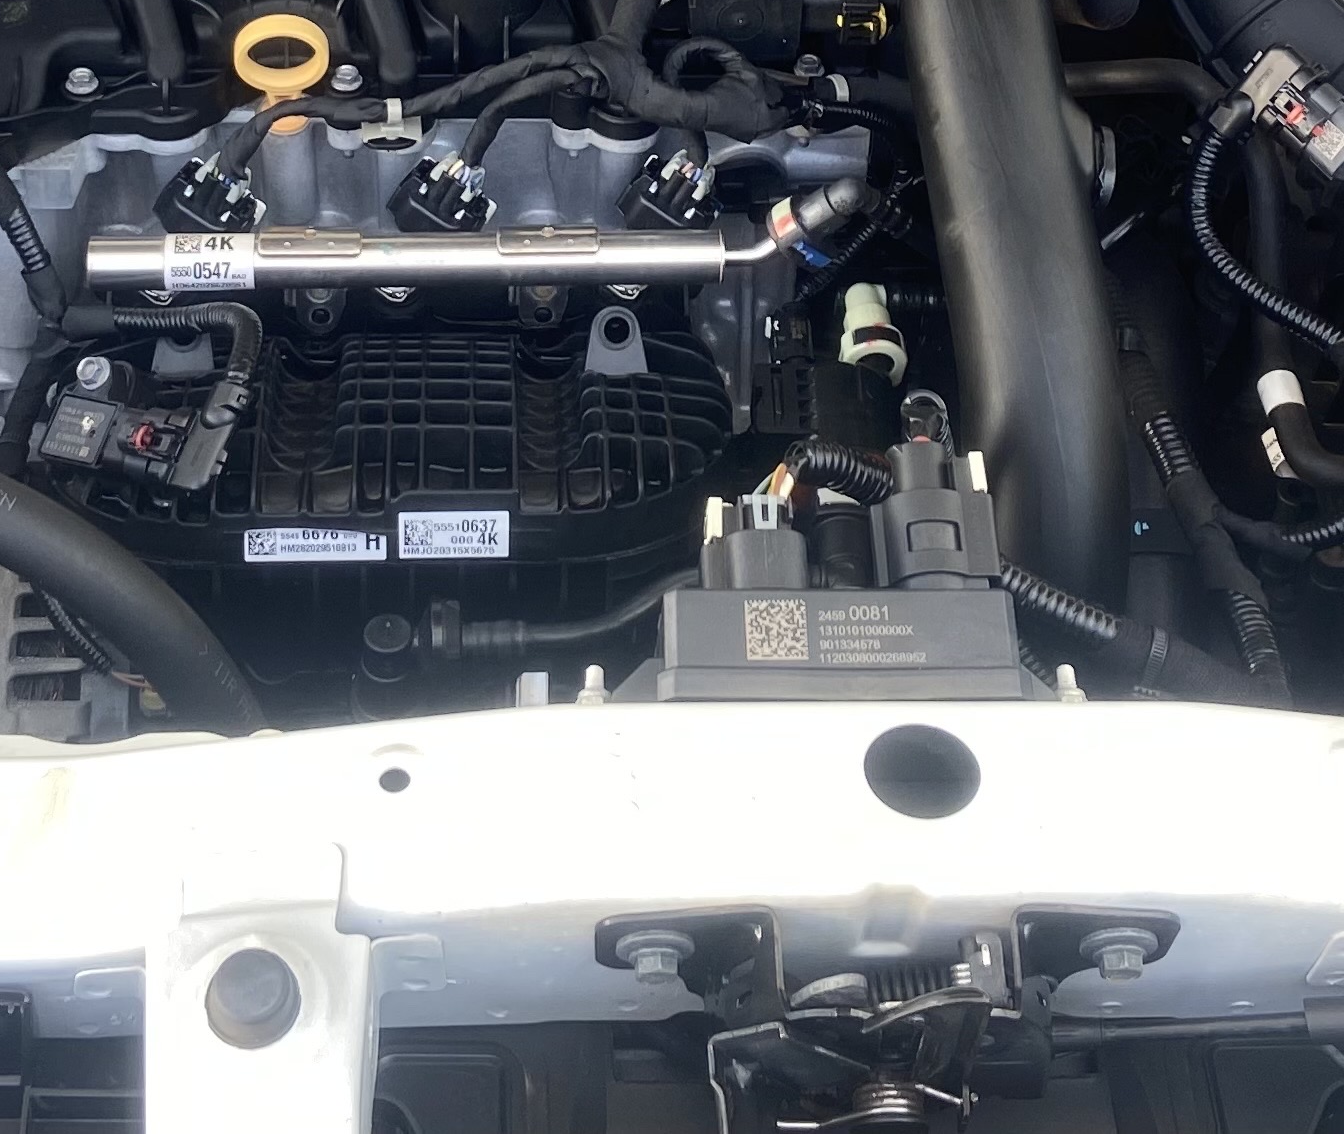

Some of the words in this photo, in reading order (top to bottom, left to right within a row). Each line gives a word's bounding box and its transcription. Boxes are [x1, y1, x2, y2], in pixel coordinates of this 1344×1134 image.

[204, 235, 235, 251] 4K
[461, 519, 497, 533] 0637
[365, 533, 380, 550] H
[477, 531, 499, 546] 4K
[848, 604, 889, 621] 0081
